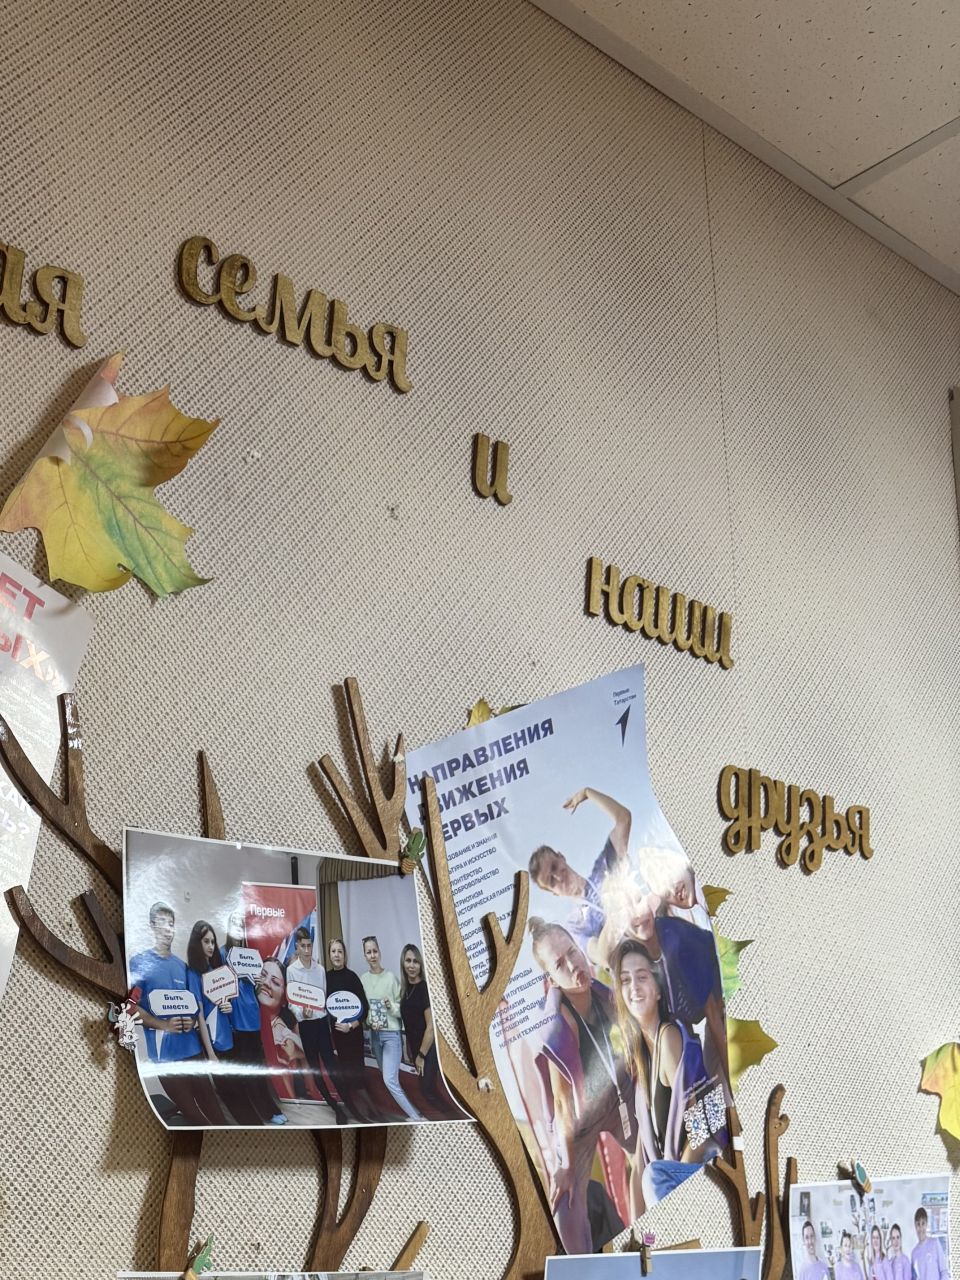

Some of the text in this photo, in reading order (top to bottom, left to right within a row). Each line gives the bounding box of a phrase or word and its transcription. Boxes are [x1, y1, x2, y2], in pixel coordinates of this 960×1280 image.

[174, 234, 413, 394] семья
[471, 431, 513, 506] и
[587, 556, 735, 670] наши
[443, 797, 509, 842] ЕРВЫХ
[718, 763, 872, 873] друзья
[250, 903, 285, 919] Первые
